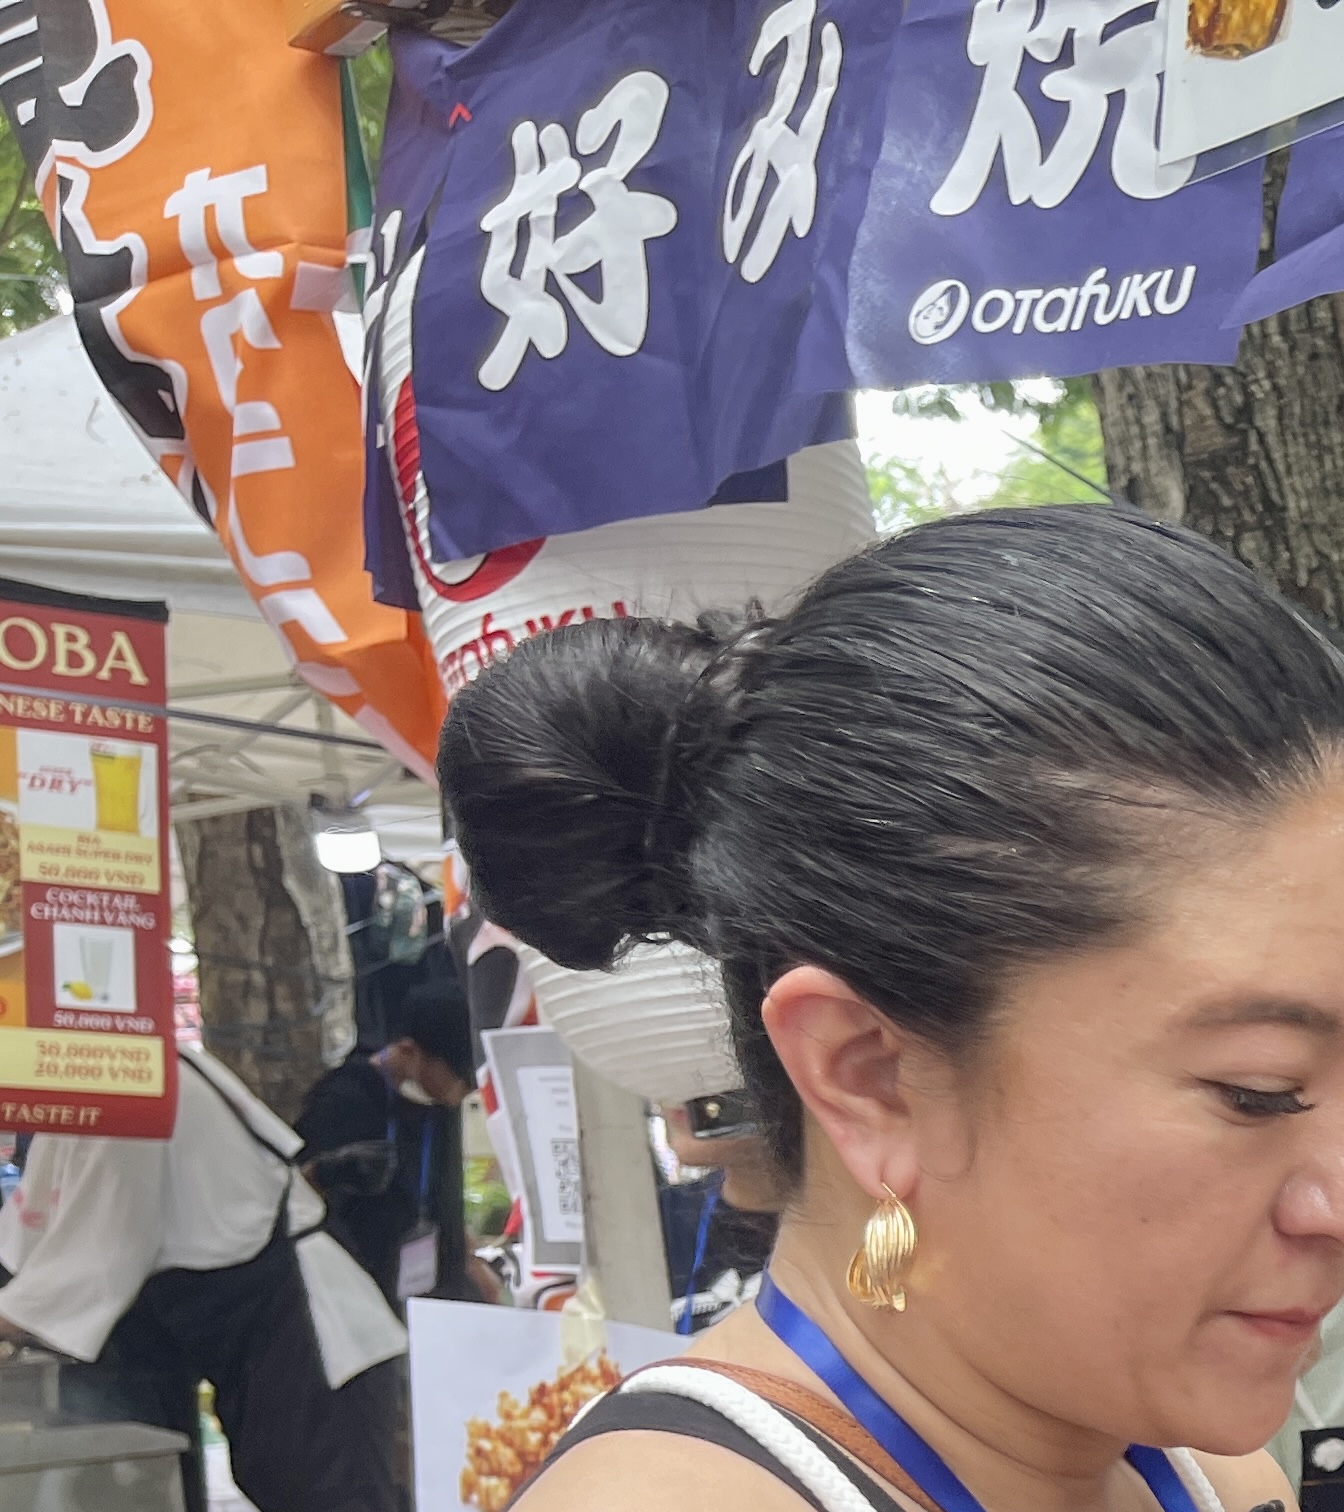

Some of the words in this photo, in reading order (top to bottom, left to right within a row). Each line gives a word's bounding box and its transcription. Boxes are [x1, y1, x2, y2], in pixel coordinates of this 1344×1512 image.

[69, 702, 154, 734] TASTE
[2, 1102, 75, 1125] TASTE
[78, 1106, 102, 1126] IT
